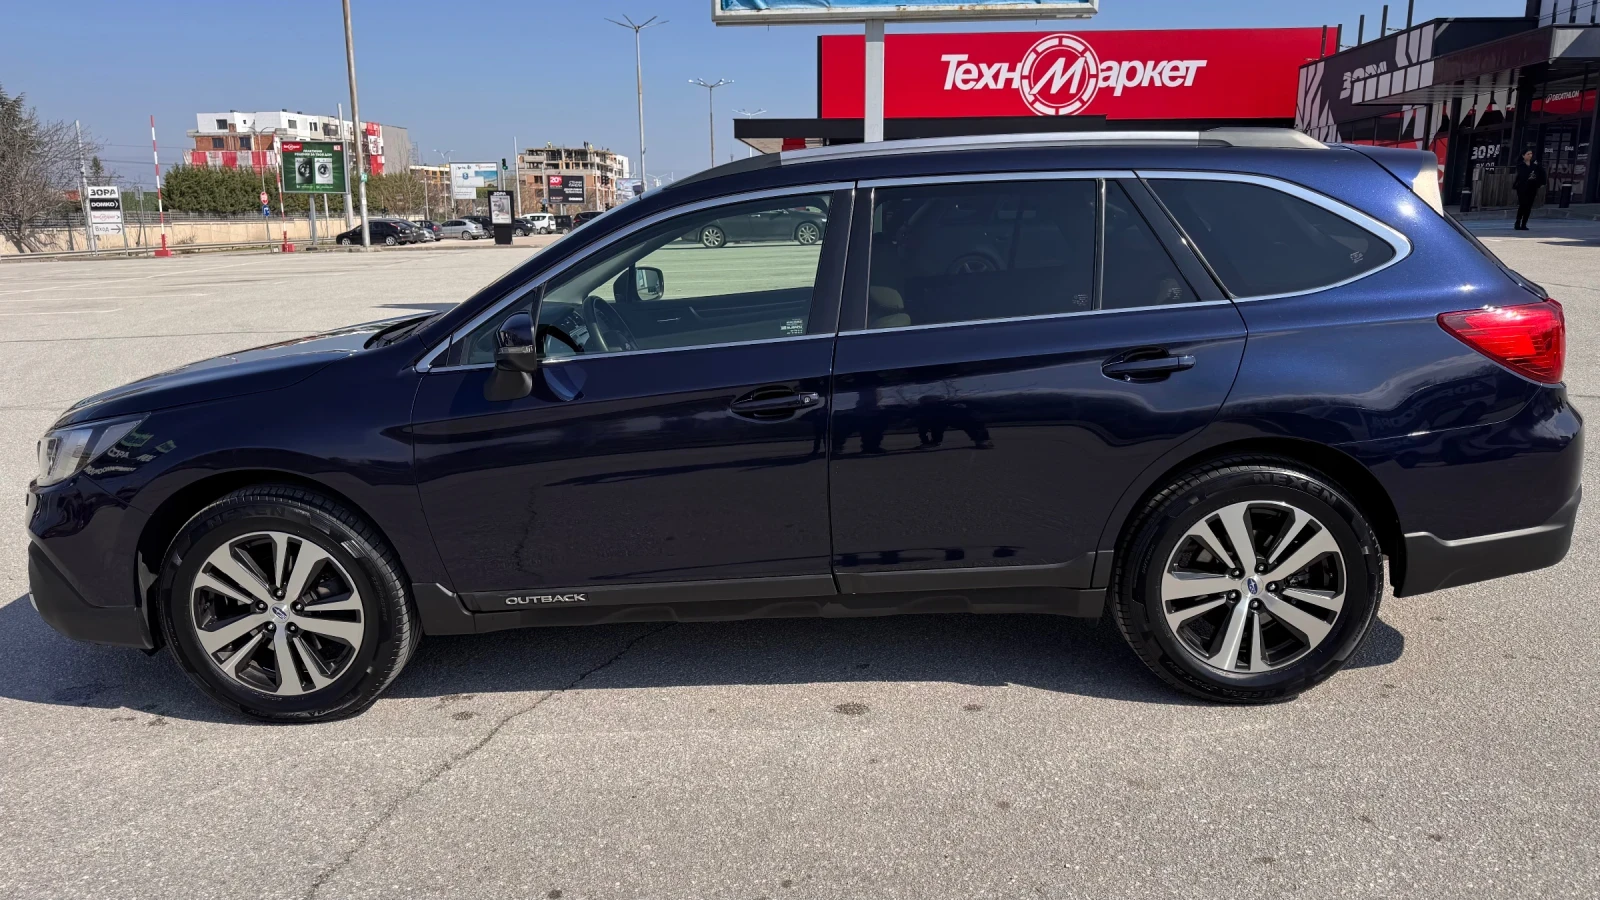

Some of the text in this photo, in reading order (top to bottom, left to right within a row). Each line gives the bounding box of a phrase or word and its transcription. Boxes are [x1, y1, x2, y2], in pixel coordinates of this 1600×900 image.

[1552, 90, 1580, 101] DECATHLON
[1253, 472, 1337, 506] NEXEN
[505, 594, 586, 605] OUTBACK
